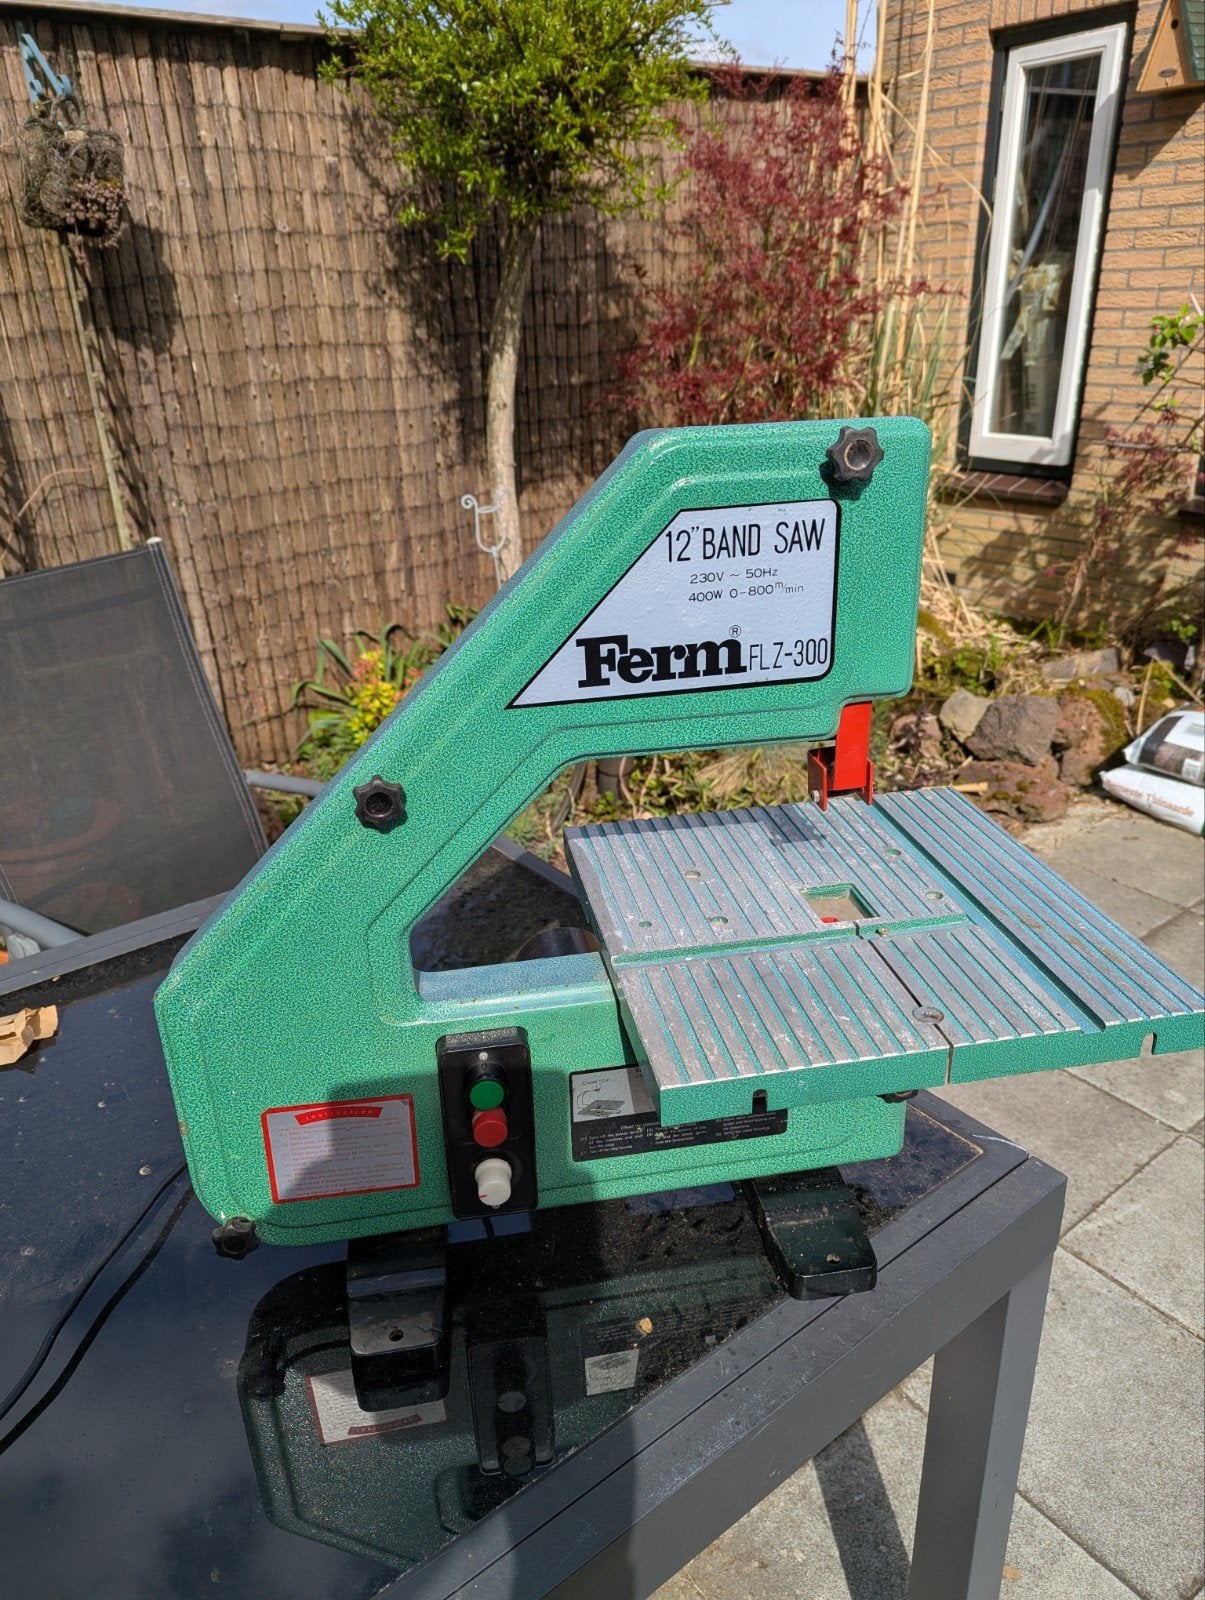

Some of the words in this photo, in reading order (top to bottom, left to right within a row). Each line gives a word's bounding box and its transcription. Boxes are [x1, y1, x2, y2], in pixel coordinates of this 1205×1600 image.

[774, 518, 826, 554] SAW
[690, 571, 725, 584] 230V
[745, 568, 778, 579] 50Hz
[688, 589, 723, 603] 400W
[749, 638, 829, 671] FLZ-300
